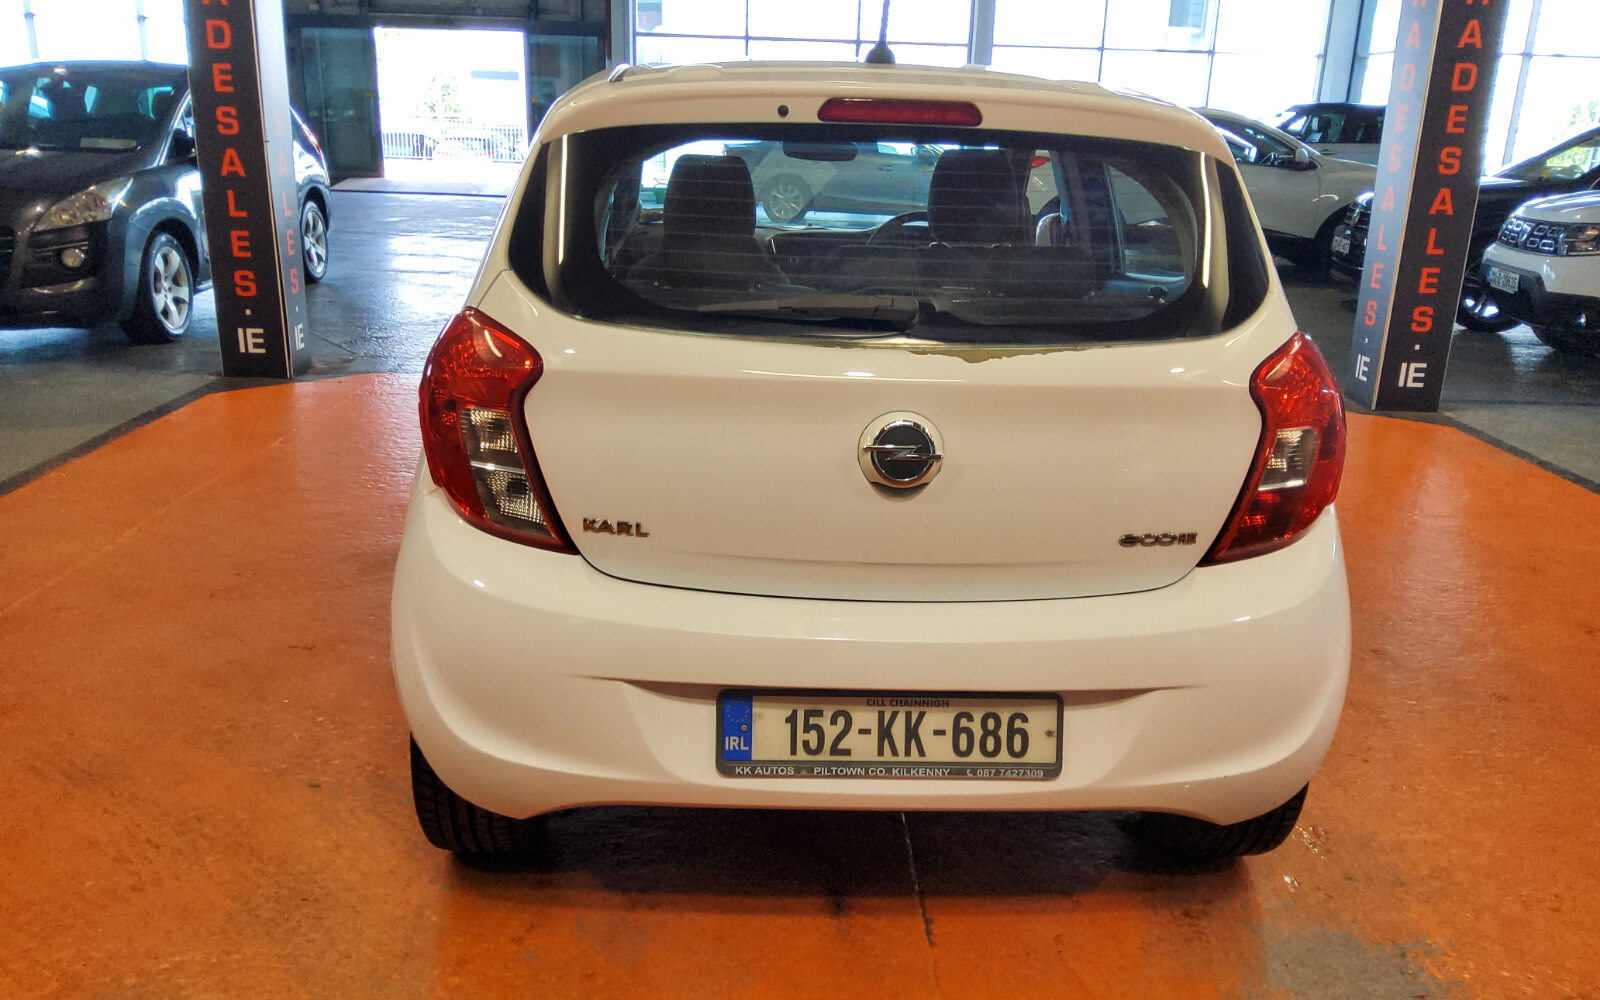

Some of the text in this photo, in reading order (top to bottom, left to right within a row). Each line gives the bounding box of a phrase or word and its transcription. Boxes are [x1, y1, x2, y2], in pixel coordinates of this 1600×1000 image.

[582, 517, 649, 537] KARL
[866, 698, 950, 708] CILL CHAINNIGH
[785, 708, 1030, 759] 152-KK-686
[725, 736, 749, 751] IRL
[735, 766, 752, 775] KK
[754, 766, 795, 775] AUTOS
[813, 766, 865, 776] PILTOWN
[868, 767, 888, 776] CO.
[892, 767, 950, 777] KILKENNY
[976, 768, 995, 777] 087
